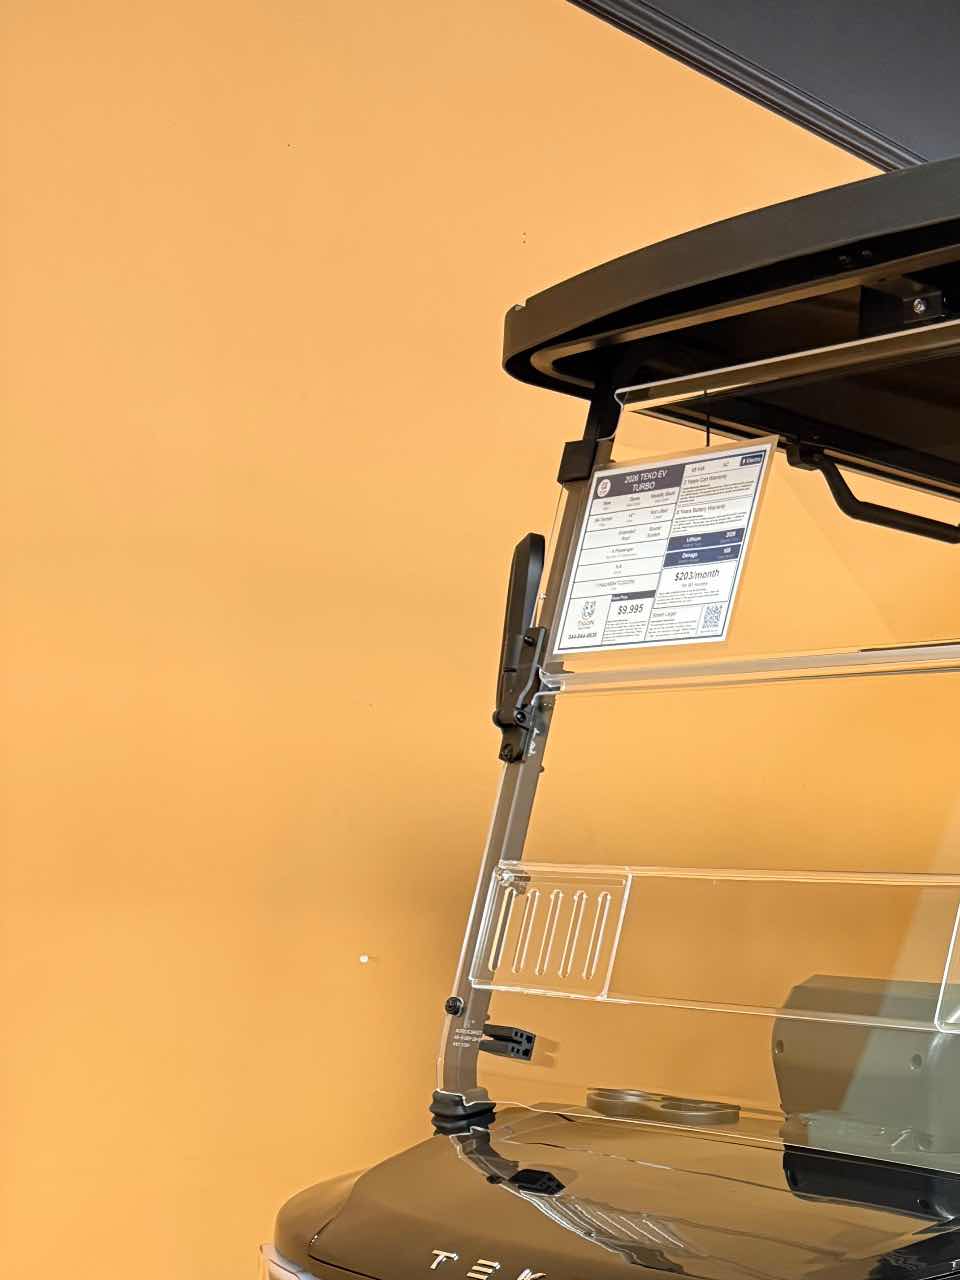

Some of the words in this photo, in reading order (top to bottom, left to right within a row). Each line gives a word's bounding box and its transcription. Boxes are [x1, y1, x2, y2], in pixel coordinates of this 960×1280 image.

[640, 471, 658, 481] TEKO
[658, 469, 668, 478] EV
[632, 481, 656, 492] TURBO
[674, 568, 720, 582] $203/month
[617, 604, 644, 616] $9,995
